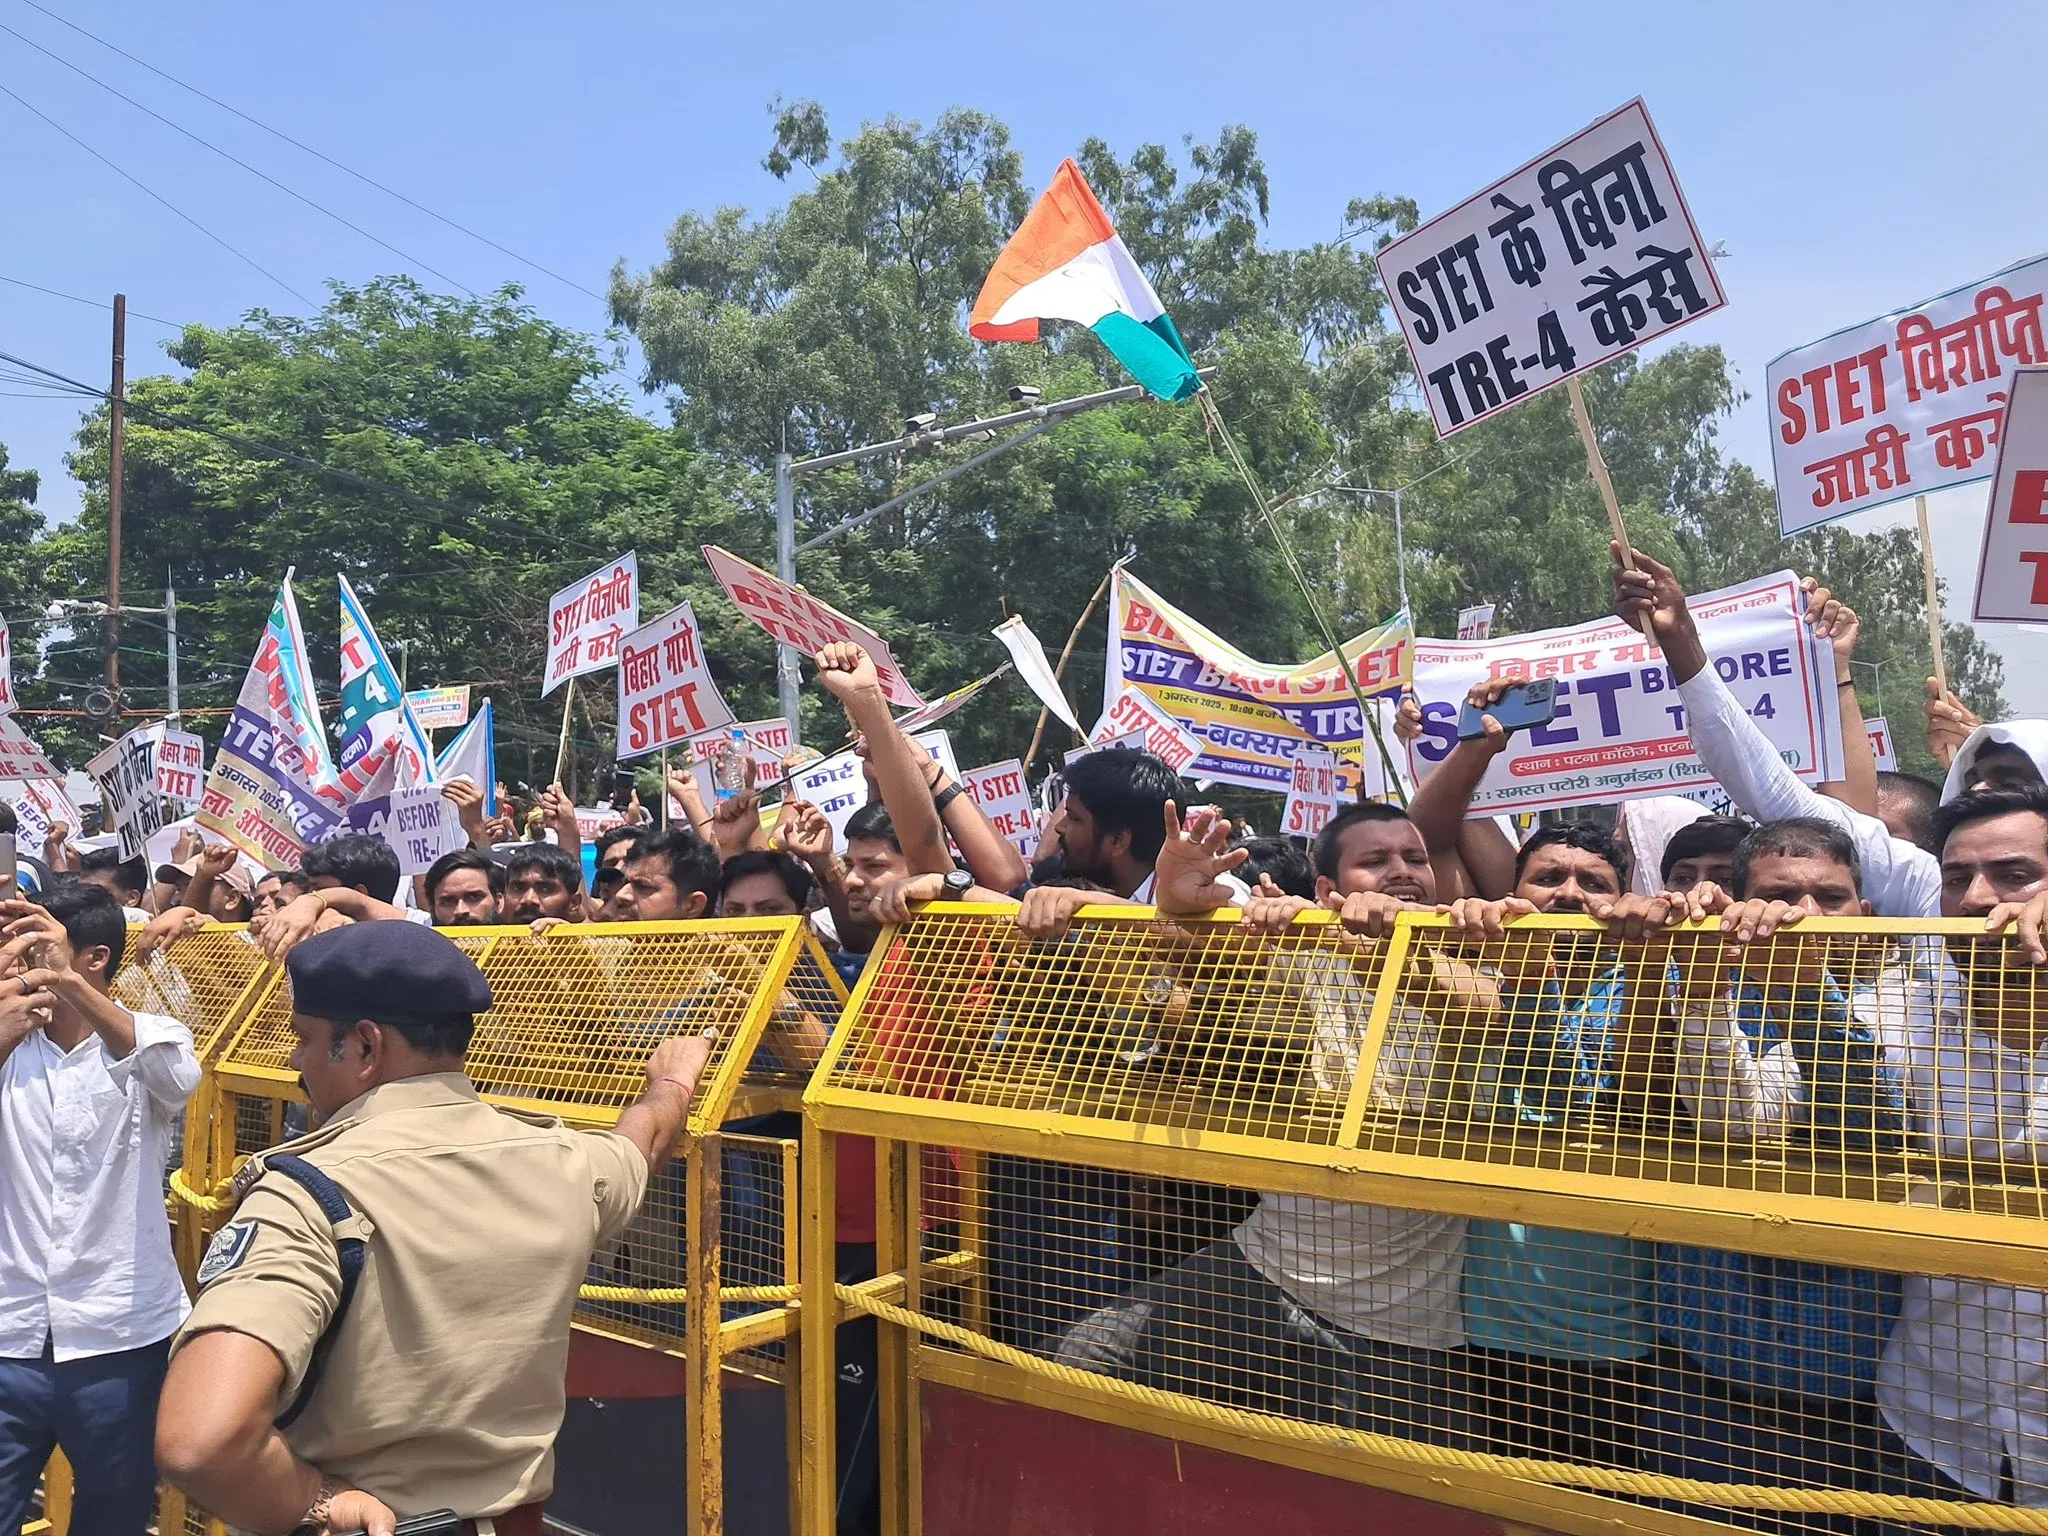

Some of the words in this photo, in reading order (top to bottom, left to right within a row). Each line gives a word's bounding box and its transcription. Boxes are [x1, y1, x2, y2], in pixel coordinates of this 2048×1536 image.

[1397, 233, 1494, 345] STET
[1488, 192, 1547, 288] के
[1537, 141, 1668, 265] बिना
[1427, 310, 1576, 426] TRE-4
[1575, 244, 1708, 346] कैसे
[1778, 344, 1887, 445] STET
[1803, 424, 1911, 507] जारी
[552, 594, 584, 647] STET
[1698, 603, 1739, 620] पटना
[1741, 593, 1778, 610] चलो
[552, 636, 582, 680] जारी
[622, 642, 661, 696] बिहार
[664, 618, 698, 675] मांगे
[1122, 647, 1193, 680] STET
[1413, 653, 1449, 665] पटना
[1453, 651, 1484, 664] चलो
[629, 682, 706, 750] STET
[1229, 703, 1254, 715] 10:00
[755, 728, 787, 750] STET
[802, 760, 854, 788] कोर्ट
[1252, 764, 1282, 777] STET
[1514, 758, 1551, 773] स्थान
[1563, 751, 1598, 766] पटना
[1602, 744, 1654, 762] कॉलेज,
[157, 766, 196, 798] STET
[216, 764, 260, 796] अगस्त
[982, 771, 1021, 801] STET
[1495, 783, 1545, 799] समस्त
[1548, 774, 1590, 792] पटोरी
[1595, 768, 1664, 788] अनुमंडल
[820, 792, 857, 813] का
[1289, 799, 1330, 836] STET
[992, 808, 1031, 836] RE-4
